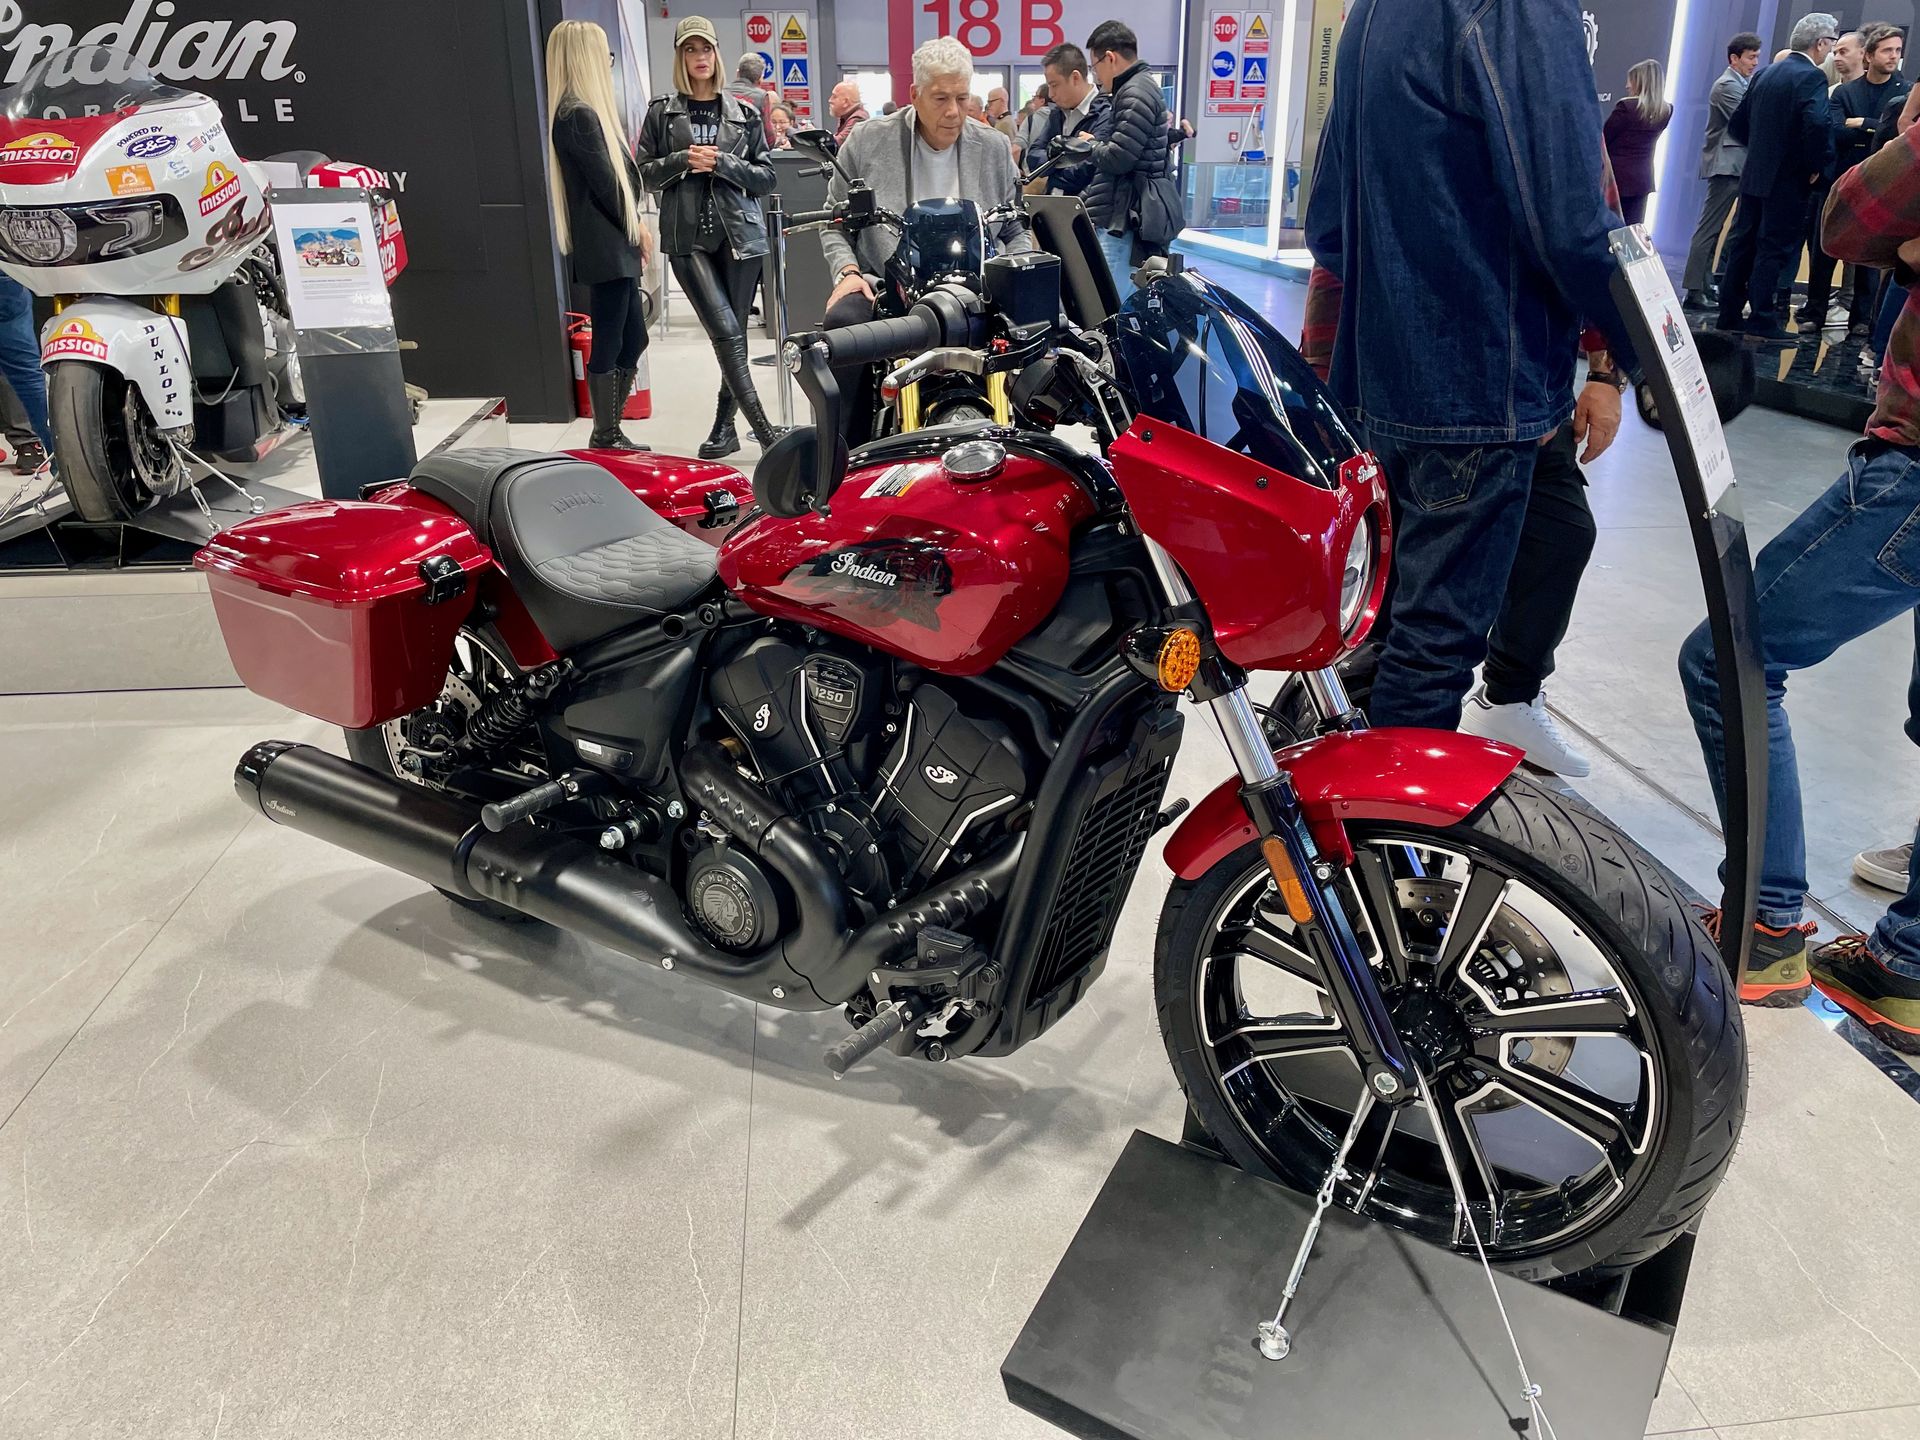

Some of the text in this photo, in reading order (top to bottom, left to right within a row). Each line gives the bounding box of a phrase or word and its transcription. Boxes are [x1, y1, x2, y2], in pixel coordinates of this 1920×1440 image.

[747, 23, 771, 35] STOP
[923, 0, 1064, 57] 18 B
[1214, 23, 1237, 35] STOP
[0, 0, 297, 87] ndian
[1318, 27, 1332, 88] SUPERVELOCE
[117, 127, 150, 148] POWERED
[132, 135, 171, 157] S&S
[143, 324, 177, 404] DUNLOP
[831, 552, 897, 587] Indian
[815, 687, 844, 703] 1250
